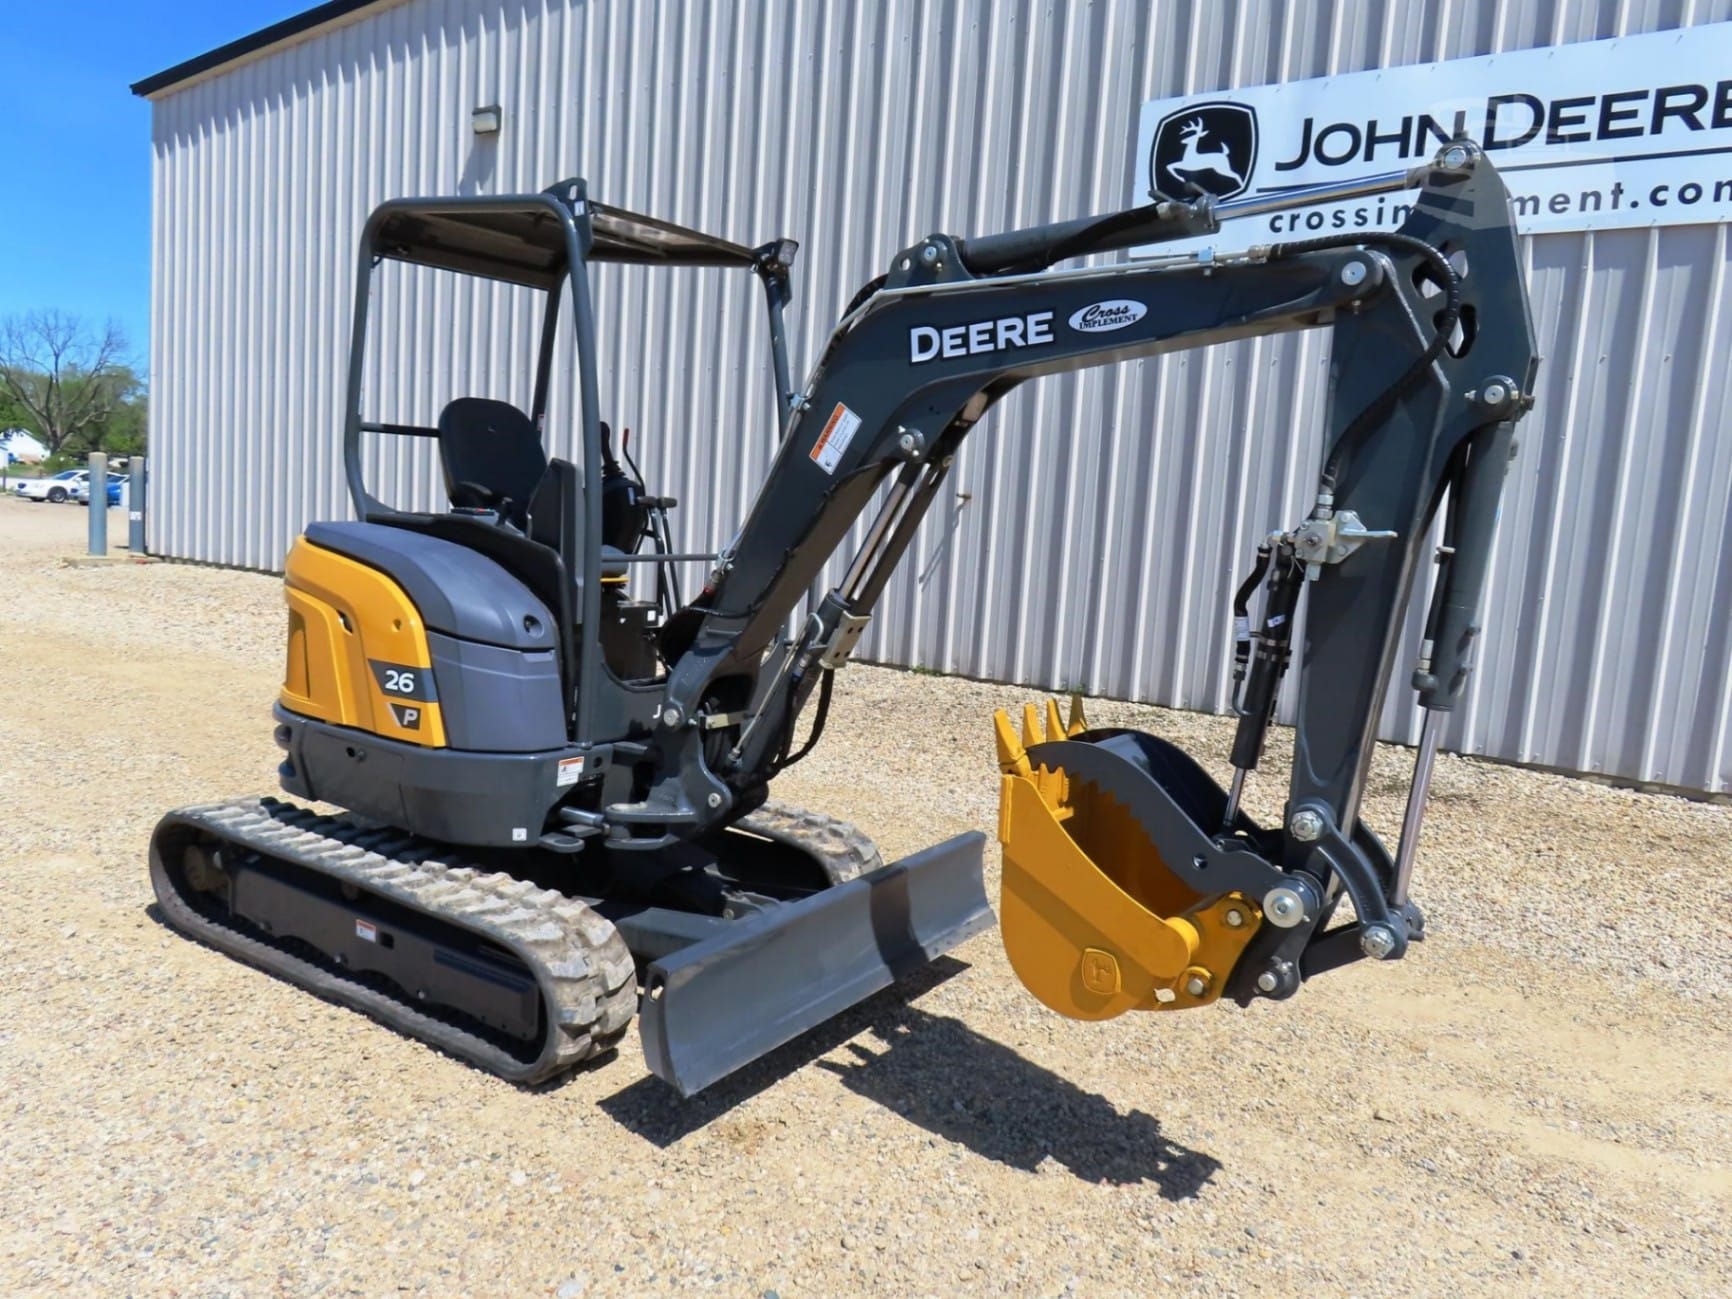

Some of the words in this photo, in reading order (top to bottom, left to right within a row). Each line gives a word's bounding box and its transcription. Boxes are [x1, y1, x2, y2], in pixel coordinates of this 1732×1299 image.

[1275, 110, 1466, 171] JOHN
[1079, 313, 1137, 329] IMPLEMENT
[1082, 304, 1129, 323] Cross
[910, 311, 1054, 363] DEERE
[385, 669, 415, 693] 26
[403, 708, 418, 725] P
